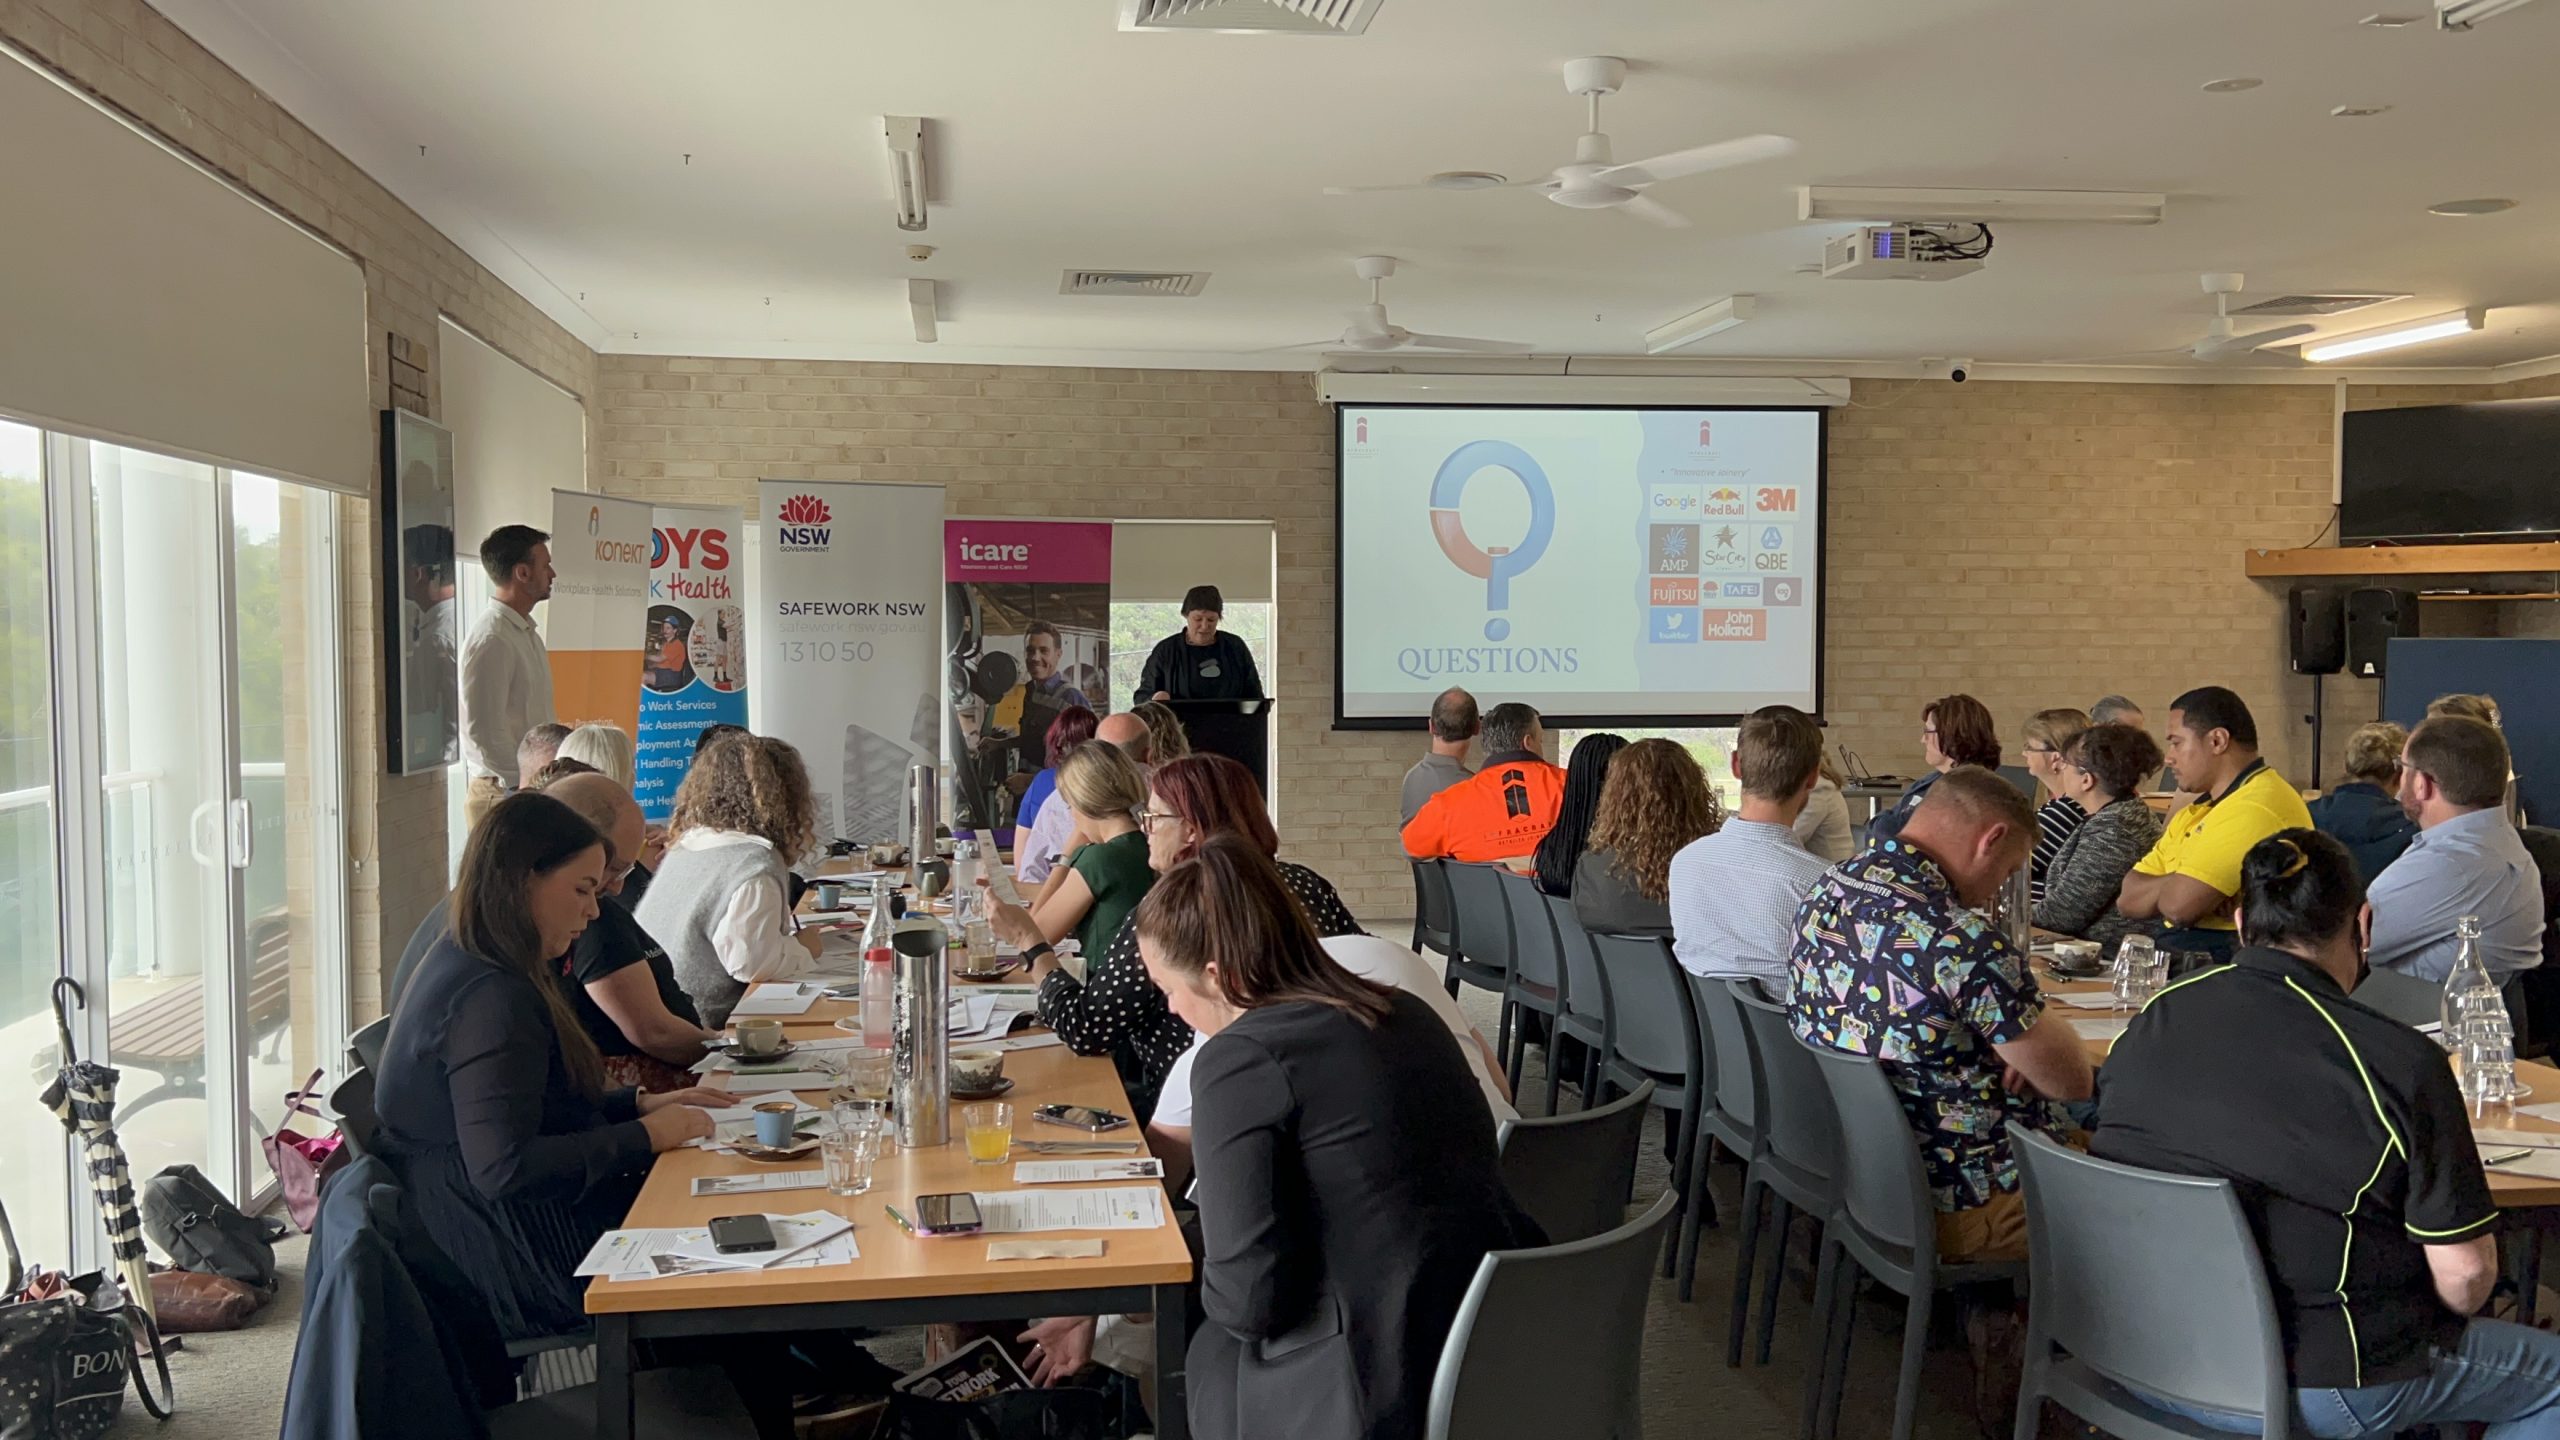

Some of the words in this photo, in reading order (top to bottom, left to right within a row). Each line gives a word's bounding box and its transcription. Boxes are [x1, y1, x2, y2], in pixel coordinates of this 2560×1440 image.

[1654, 493, 1697, 510] Google
[1755, 487, 1796, 512] 3M
[1703, 504, 1724, 515] Red
[1725, 504, 1745, 515] Bull
[780, 528, 830, 545] NSW
[959, 537, 1029, 561] icare
[1660, 559, 1689, 572] AMP
[1755, 553, 1788, 571] QBE
[667, 572, 731, 601] Health
[1726, 585, 1752, 595] TAFE
[1653, 587, 1697, 603] FUJITSU
[779, 602, 880, 616] SAFEWORK
[885, 603, 926, 616] NSW
[1725, 611, 1753, 624] John
[1708, 623, 1753, 637] Holland
[1397, 647, 1579, 681] QUESTIONS
[648, 700, 674, 711] Work
[676, 700, 717, 711] Services
[655, 720, 718, 730] Assessments
[641, 757, 684, 770] Handling
[1863, 882, 1893, 898] STARTER
[73, 1348, 127, 1379] BON
[936, 1367, 1001, 1402] ETWORK
